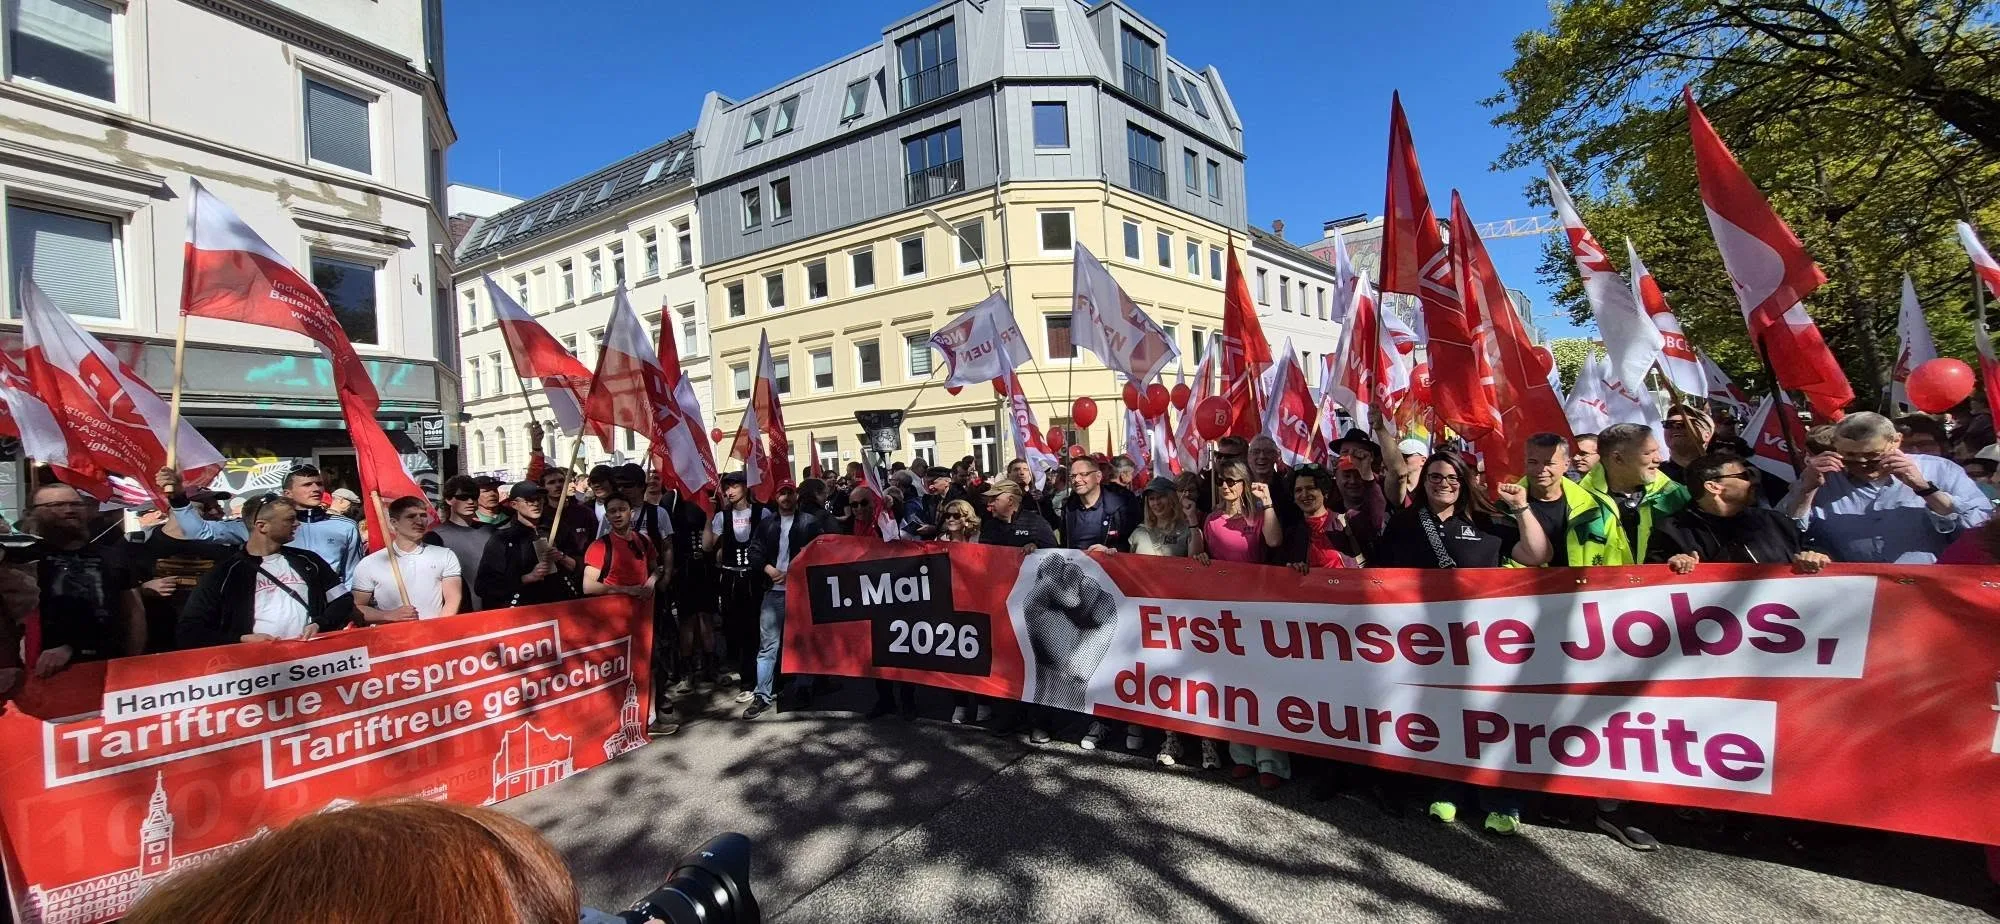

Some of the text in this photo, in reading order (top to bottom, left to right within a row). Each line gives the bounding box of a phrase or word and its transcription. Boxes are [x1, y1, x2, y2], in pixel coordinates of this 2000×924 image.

[826, 566, 931, 608] 1. Mai
[888, 619, 980, 660] 2026
[1138, 592, 1841, 667] Erst unsere Jobs,
[62, 691, 322, 765] Tariftreue
[336, 637, 552, 705] versprochen
[116, 654, 365, 715] Hamburger Senat:
[280, 701, 473, 767] Tariftreue
[482, 654, 625, 718] gebrochen
[1114, 662, 1767, 783] dann eure Profite
